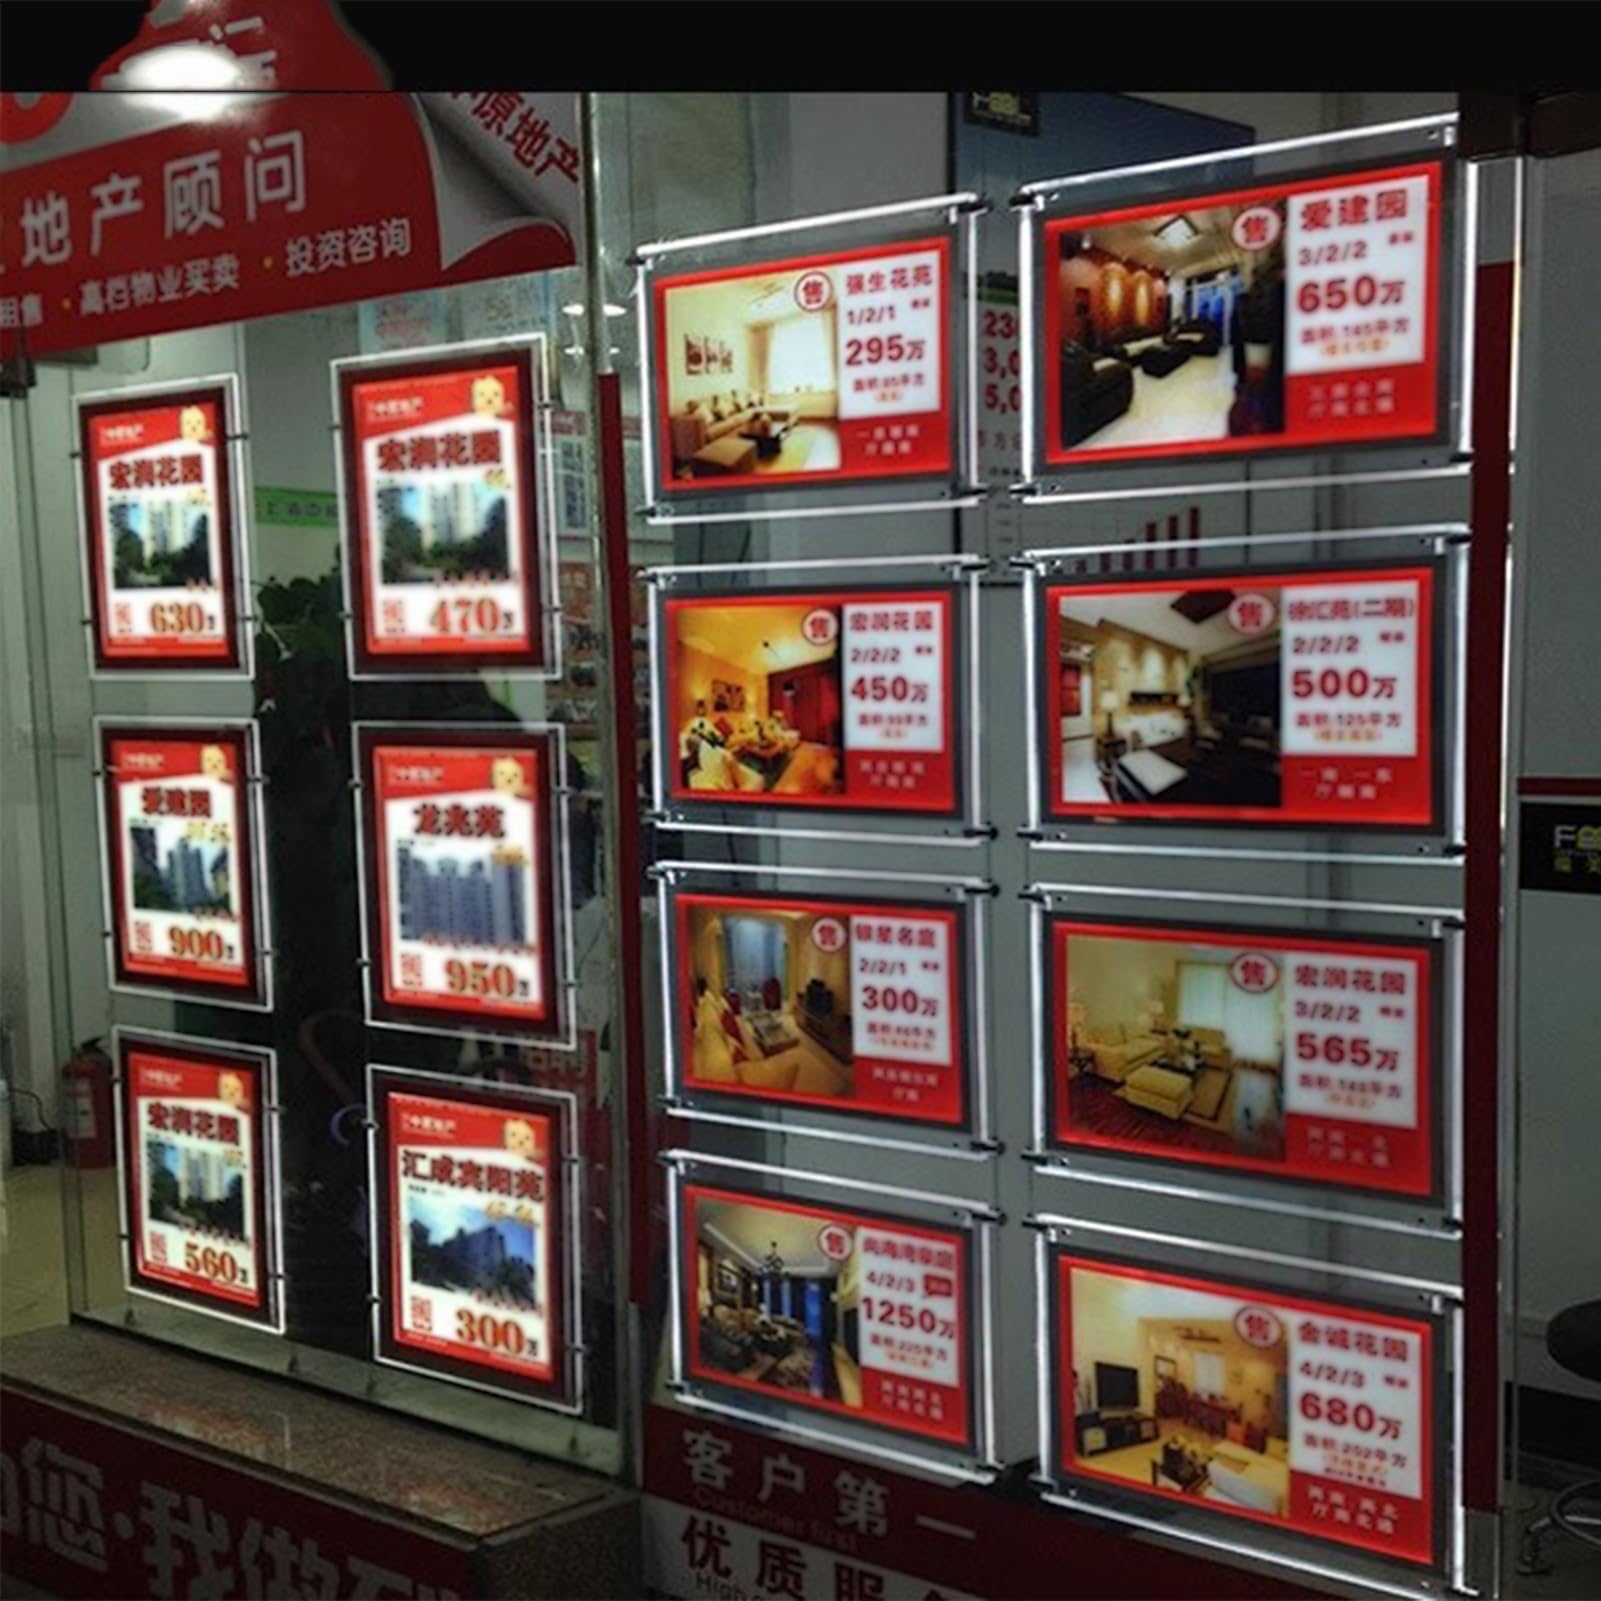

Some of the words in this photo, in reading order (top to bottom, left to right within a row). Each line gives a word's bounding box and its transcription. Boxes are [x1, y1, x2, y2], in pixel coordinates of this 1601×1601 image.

[452, 91, 579, 183] 原地产
[0, 131, 305, 274] 地产顾问
[285, 217, 412, 277] 投资咨询
[1299, 241, 1366, 266] 3/2/2
[1297, 275, 1405, 313] 650万
[847, 305, 895, 325] 1/2/1
[984, 311, 1020, 339] 23
[846, 334, 925, 367] 295万
[851, 648, 900, 663] 2/2/2
[1292, 635, 1359, 654] 2/2/2
[851, 675, 928, 702] 450万
[1291, 668, 1397, 699] 500万
[859, 958, 906, 975] 2/2/1
[1296, 965, 1406, 995] 宏润花园
[862, 985, 938, 1017] 300万
[1295, 1001, 1360, 1022] 3/2/2
[1297, 1033, 1399, 1071] 565万
[866, 1271, 915, 1293] 4/2/3
[862, 1297, 954, 1339] 1250万
[1299, 1362, 1365, 1388] 4/2/3
[1300, 1392, 1402, 1440] 680万
[682, 1429, 977, 1541] 客户第一
[681, 1515, 945, 1601] 优质服
